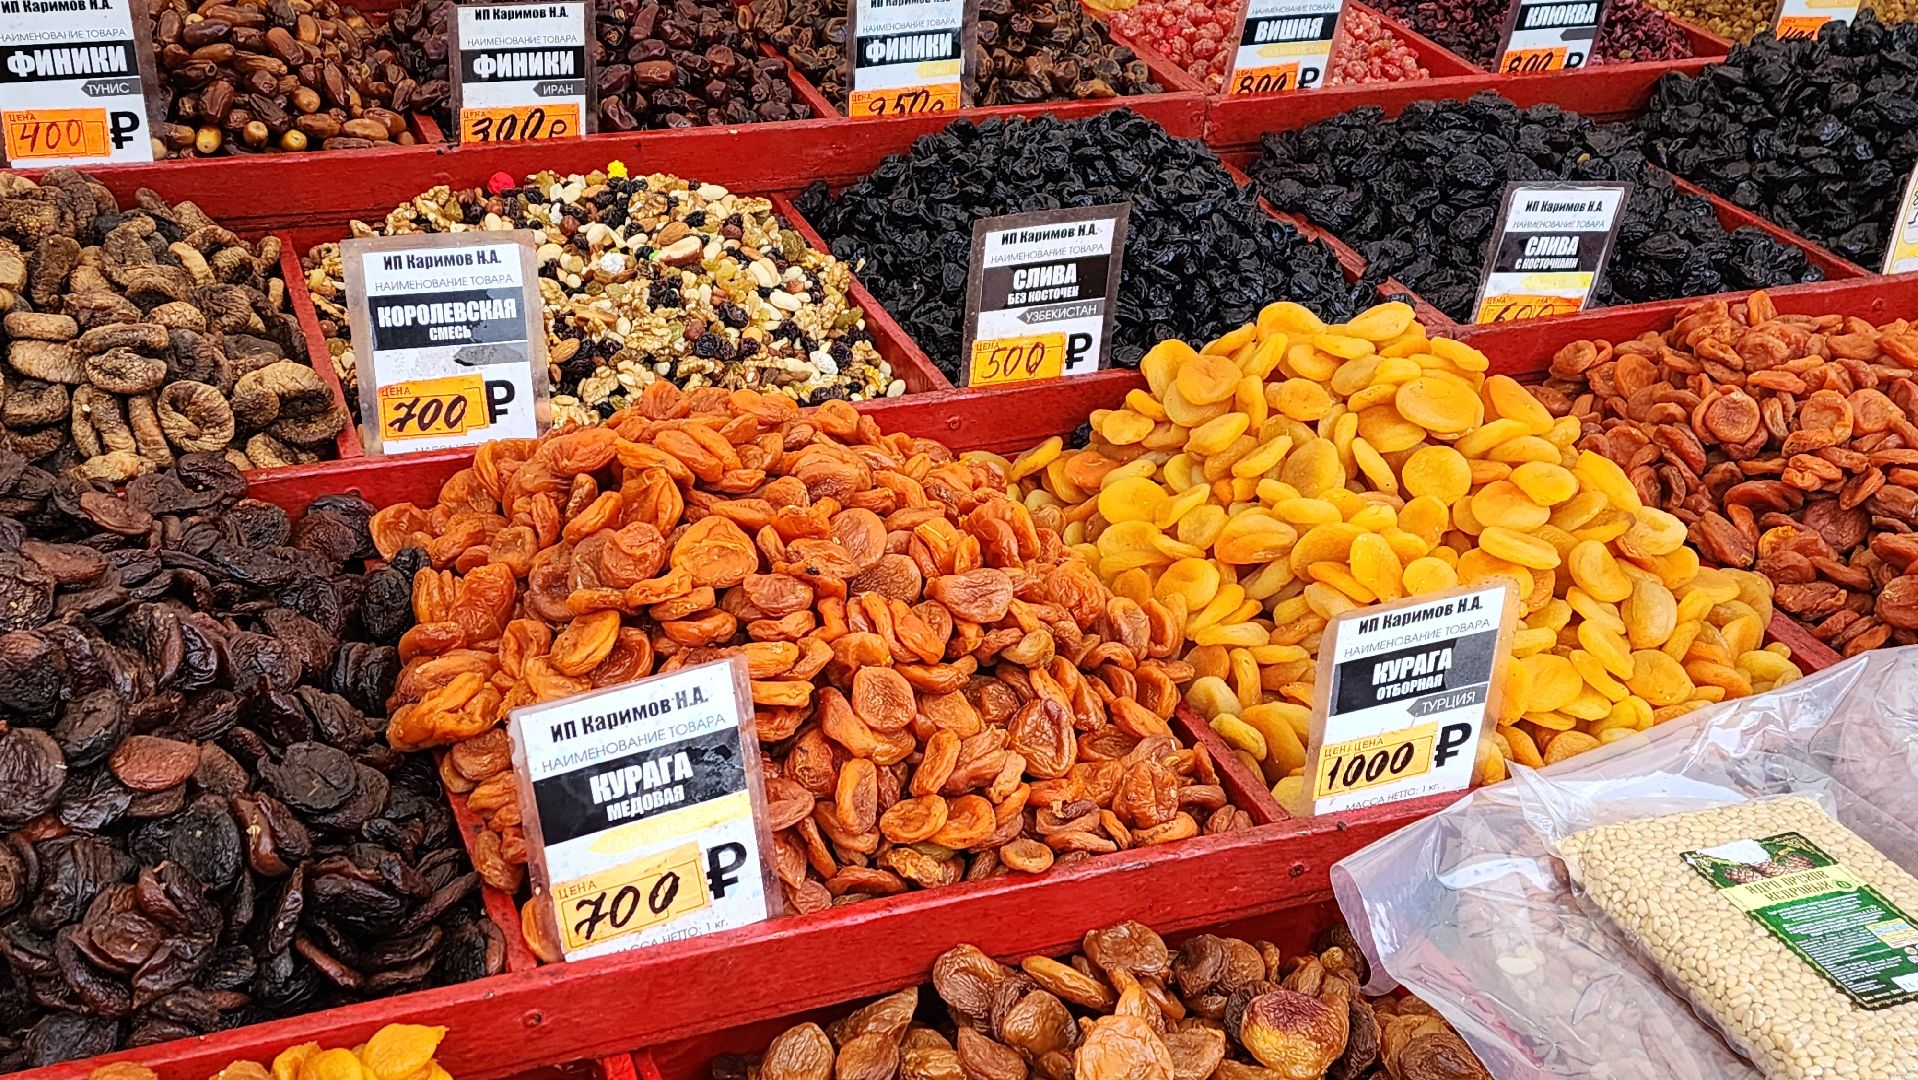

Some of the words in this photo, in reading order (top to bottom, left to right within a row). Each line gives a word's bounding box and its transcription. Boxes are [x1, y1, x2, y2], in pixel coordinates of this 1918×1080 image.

[1, 0, 20, 13] ИП
[23, 0, 86, 13] Каримов
[475, 9, 490, 21] ИП
[493, 8, 547, 21] Каримов
[549, 6, 569, 18] Н.А.
[1524, 3, 1598, 27] КЛЮКВА
[86, 28, 126, 39] ТОВАРА
[863, 21, 924, 33] НАИМЕНОВАНИЕ
[926, 17, 956, 27] ТОВАРА
[1254, 17, 1324, 42] ВИШНЯ
[467, 36, 541, 47] НАИМЕНОВАНИЕ
[544, 34, 578, 44] ТОВАРА
[866, 33, 952, 62] ФИНИКИ
[7, 46, 128, 77] ФИНИКИ
[473, 50, 574, 78] ФИНИКИ
[87, 82, 130, 95] ТУНИС
[543, 84, 573, 95] ИРАН
[1236, 72, 1287, 94] 800
[8, 114, 36, 122] ЦЕНА
[463, 111, 486, 119] ЦЕНА
[471, 108, 545, 142] 300
[20, 119, 82, 152] 400
[1525, 201, 1539, 212] ИП
[1540, 200, 1586, 213] Каримов
[1001, 232, 1017, 246] ИП
[1019, 226, 1075, 244] Каримов
[1077, 223, 1098, 236] Н.А.
[1512, 220, 1575, 229] НАИМЕНОВАНИЕ
[1577, 220, 1605, 229] ТОВАРА
[991, 247, 1067, 264] НАИМЕНОВАНИЕ
[1069, 243, 1104, 255] ТОВАРА
[1524, 236, 1580, 257] СЛИВА
[383, 255, 402, 271] ИП
[407, 253, 473, 270] Каримов
[477, 249, 502, 264] Н.А.
[1522, 257, 1578, 270] КОСТОЧКАМИ
[375, 276, 468, 292] НАИМЕНОВАНИЕ
[470, 273, 514, 286] ТОВАРА
[1013, 263, 1077, 290] СЛИВА
[1007, 292, 1027, 305] БЕЗ
[1028, 286, 1079, 302] КОСТОЧЕК
[377, 298, 517, 328] КОРОЛЕВСКАЯ
[1025, 304, 1097, 323] УЗБЕКИСТАН
[429, 325, 472, 341] СМЕСЬ
[976, 343, 999, 352] ЦЕНА
[981, 342, 1045, 379] 500
[382, 386, 411, 397] ЦЕНА
[388, 394, 468, 433] 700
[1358, 619, 1379, 635] ИП
[1382, 603, 1453, 629] Каримов
[1457, 596, 1483, 614] Н.А.
[1344, 629, 1442, 658] НАИМЕНОВАНИЕ
[1445, 618, 1490, 636] ТОВАРА
[1372, 647, 1452, 686] КУРАГА
[1376, 673, 1444, 701] ОТБОРНАЯ
[1422, 691, 1475, 714] ТУРЦИЯ
[550, 720, 577, 743] ИП
[582, 697, 672, 735] Каримов
[675, 686, 709, 711] Н.А.
[542, 728, 666, 774] НАИМЕНОВАНИЕ
[669, 713, 726, 738] ТОВАРА
[1354, 737, 1384, 752] ЦЕНА
[1328, 742, 1415, 790] 1000
[589, 751, 693, 805] КУРАГА
[607, 784, 685, 822] МЕДОВАЯ
[1346, 796, 1385, 810] МАССА
[1387, 788, 1419, 802] НЕТТО:
[558, 880, 597, 899] ЦЕНА
[574, 871, 680, 940] 700
